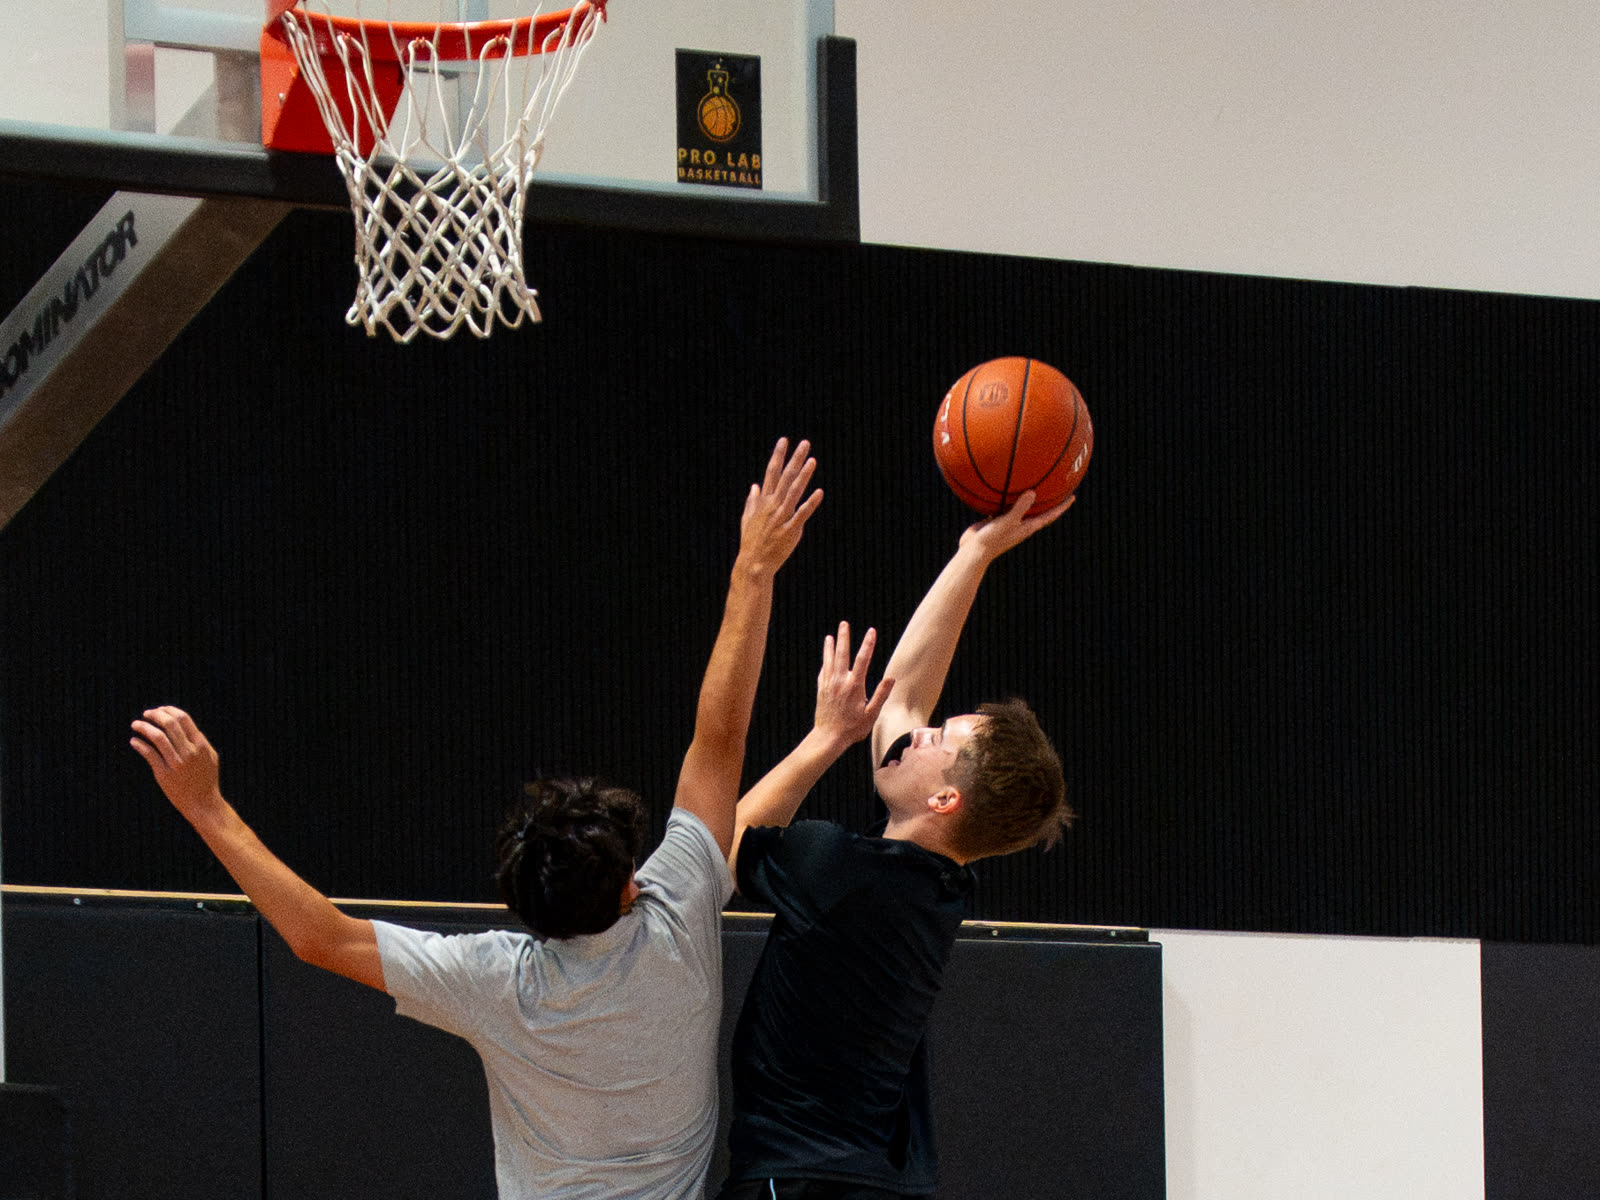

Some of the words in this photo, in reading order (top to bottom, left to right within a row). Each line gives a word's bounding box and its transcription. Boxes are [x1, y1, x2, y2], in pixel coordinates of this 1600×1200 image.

[678, 147, 717, 165] PRO
[727, 151, 761, 169] LAB
[678, 167, 761, 184] BASKETBALL
